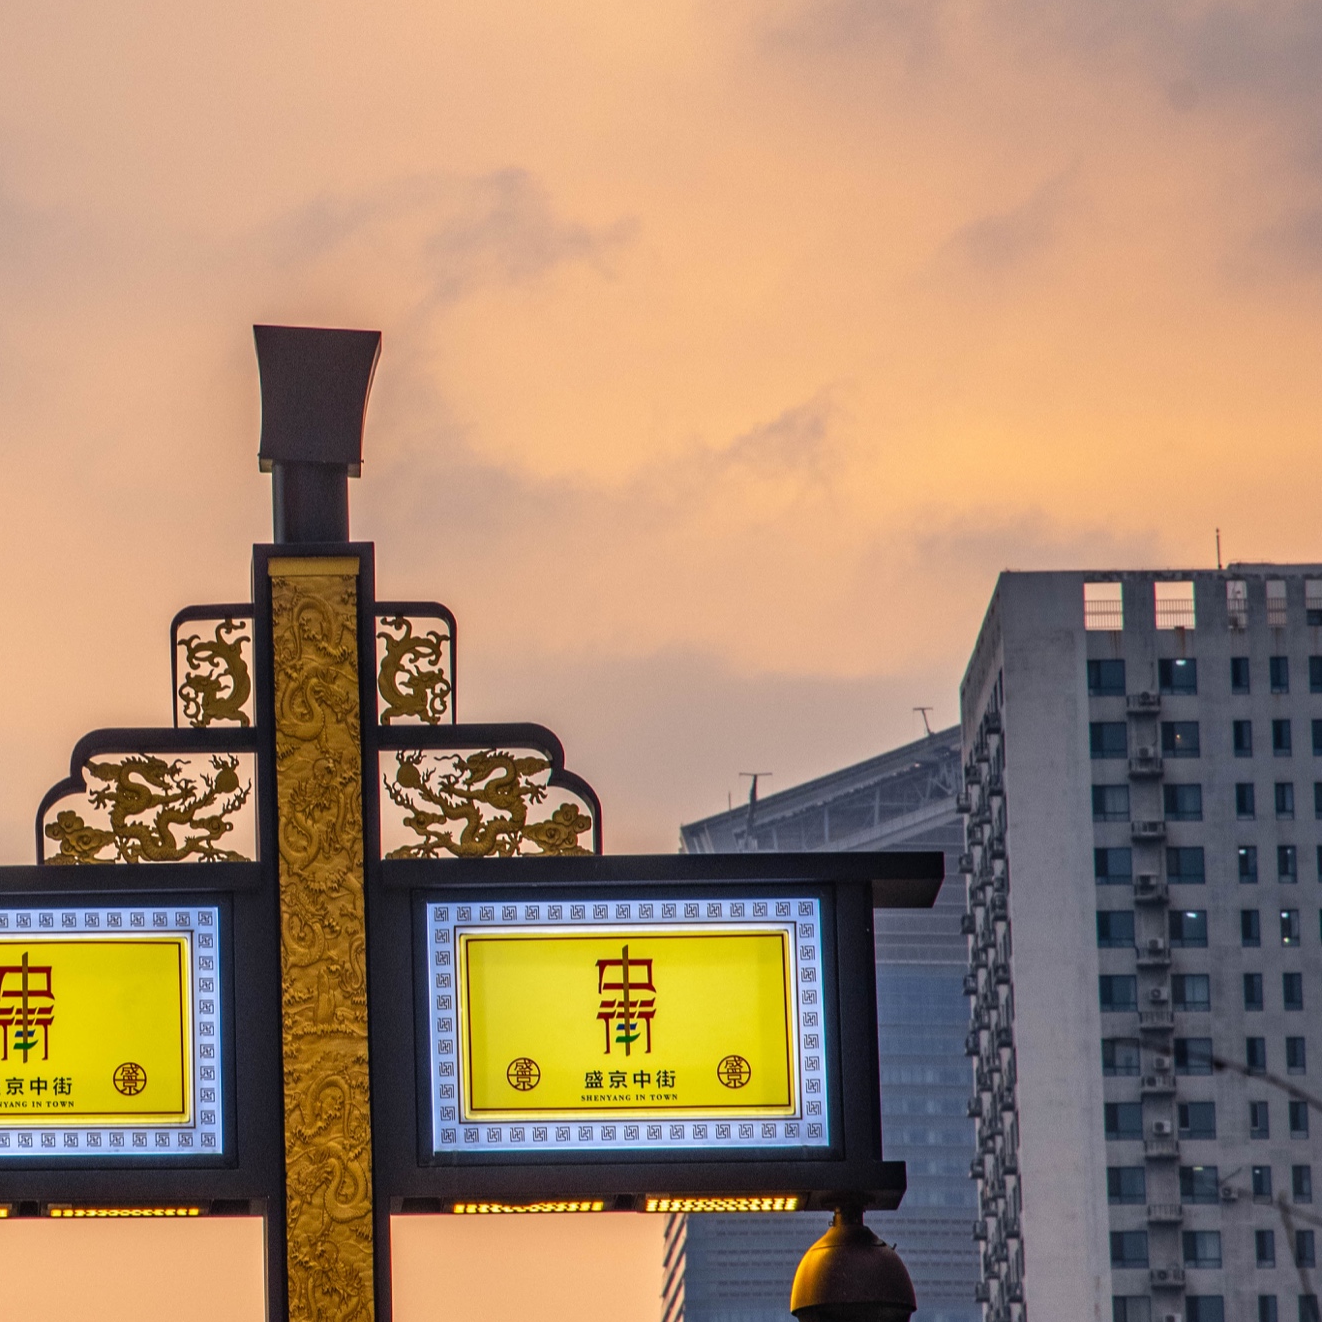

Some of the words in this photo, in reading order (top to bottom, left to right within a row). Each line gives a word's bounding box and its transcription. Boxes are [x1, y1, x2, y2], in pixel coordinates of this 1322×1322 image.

[585, 1070, 676, 1089] 盛京中街
[581, 1094, 631, 1102] SHENYANG
[649, 1093, 678, 1101] TOWN
[47, 1100, 75, 1108] TOWN
